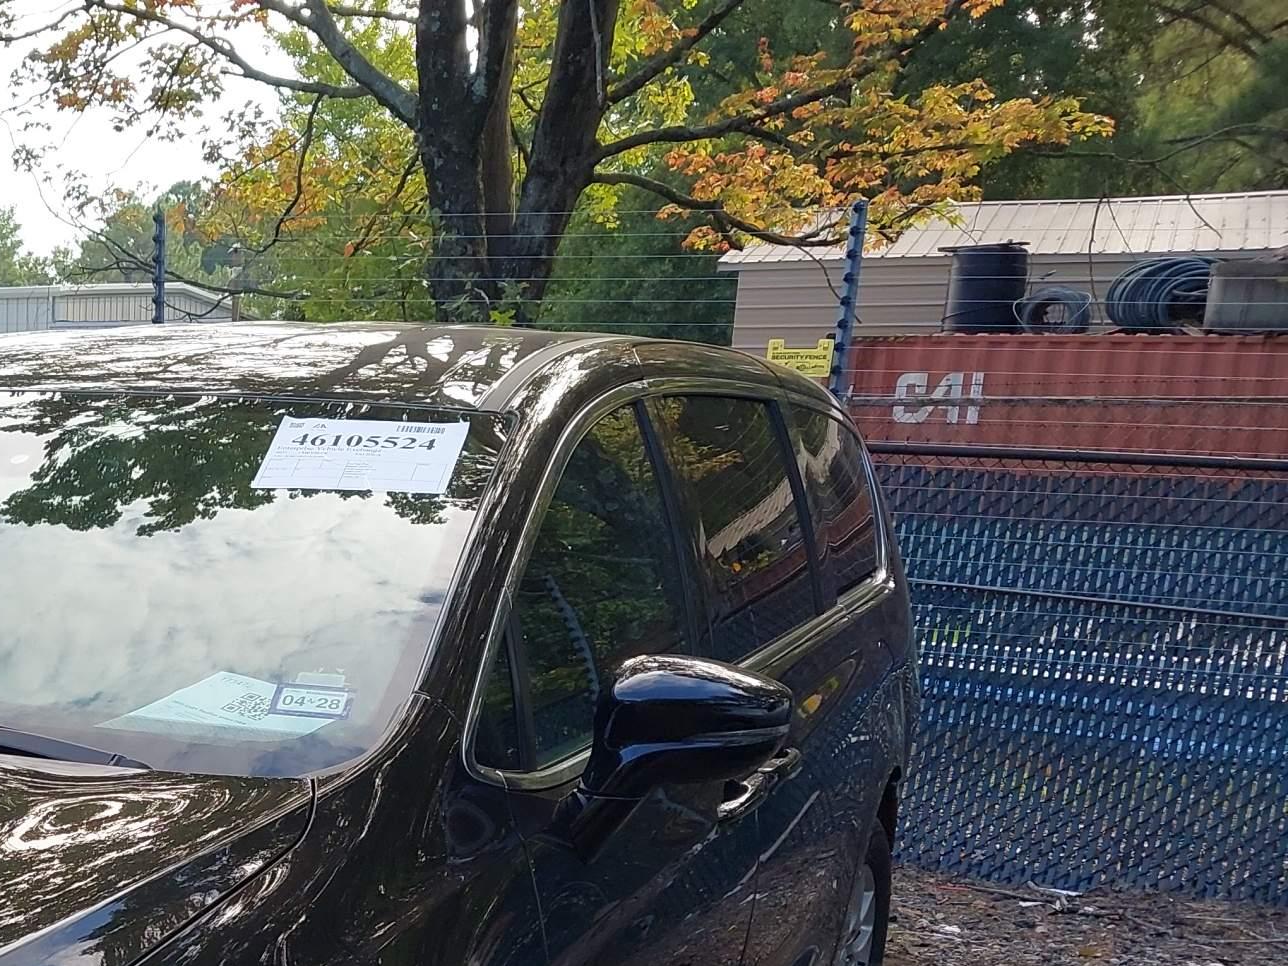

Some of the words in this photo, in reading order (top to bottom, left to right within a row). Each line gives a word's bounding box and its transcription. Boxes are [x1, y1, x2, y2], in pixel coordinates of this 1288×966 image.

[893, 372, 985, 424] CAI
[292, 433, 437, 451] 46105524
[282, 694, 306, 707] 04
[315, 697, 341, 710] 28
